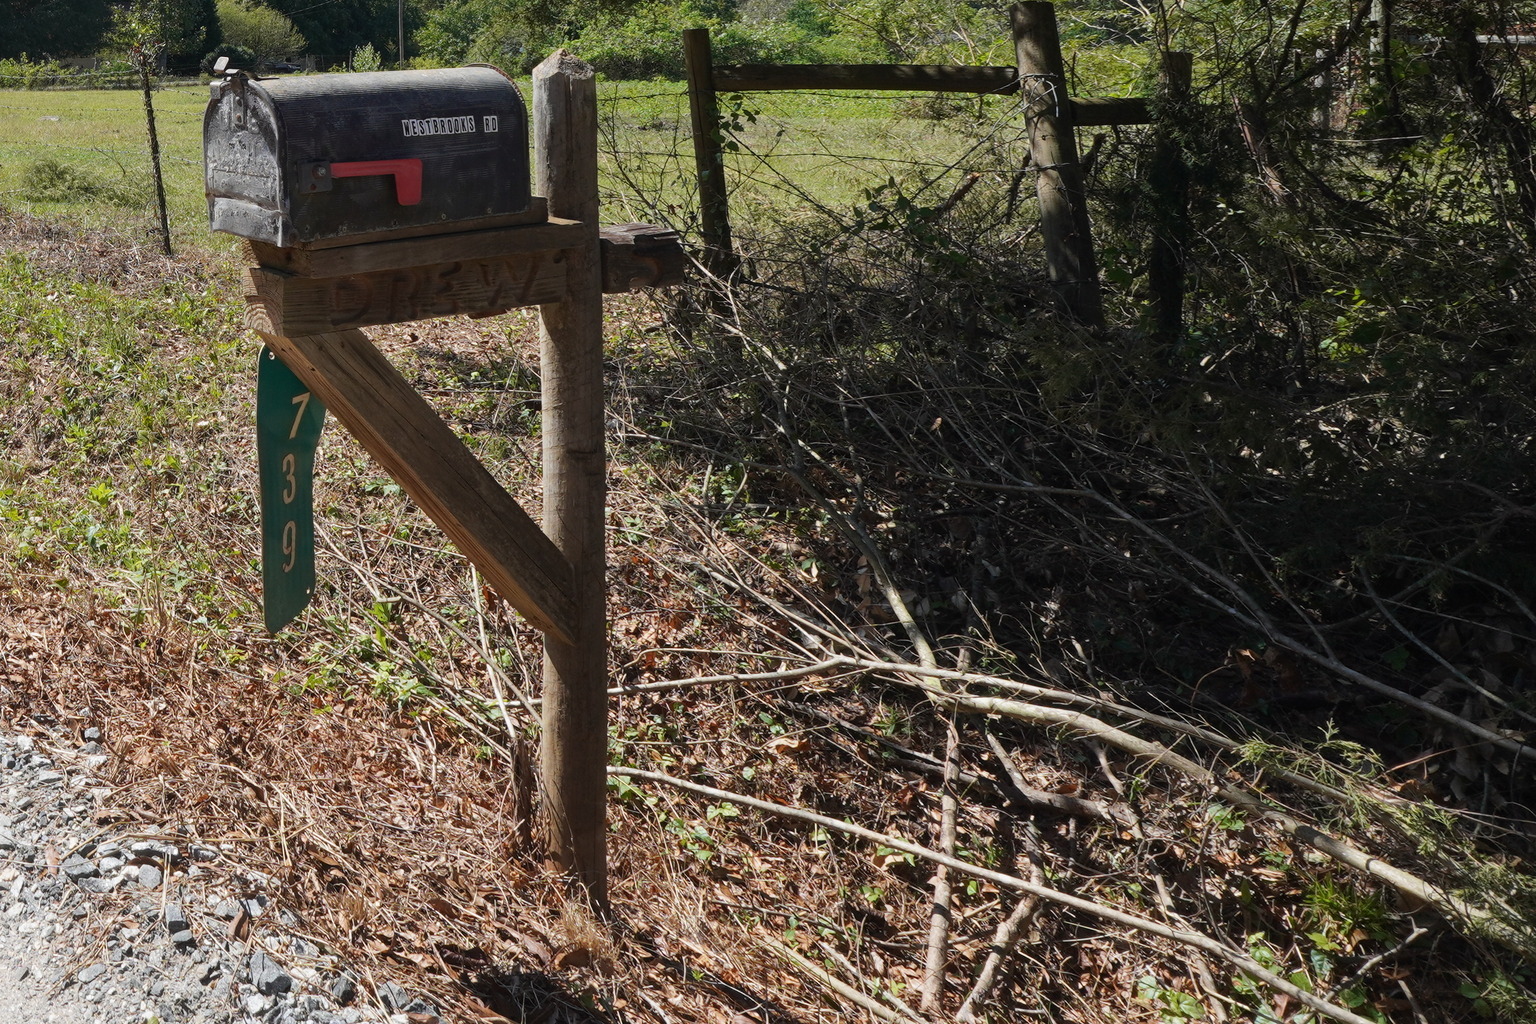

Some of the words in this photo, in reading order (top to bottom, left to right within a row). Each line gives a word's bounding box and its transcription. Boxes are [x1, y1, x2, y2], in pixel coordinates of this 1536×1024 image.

[403, 117, 475, 136] WESTBROOKS
[484, 116, 498, 132] RD
[282, 392, 311, 573] 739
